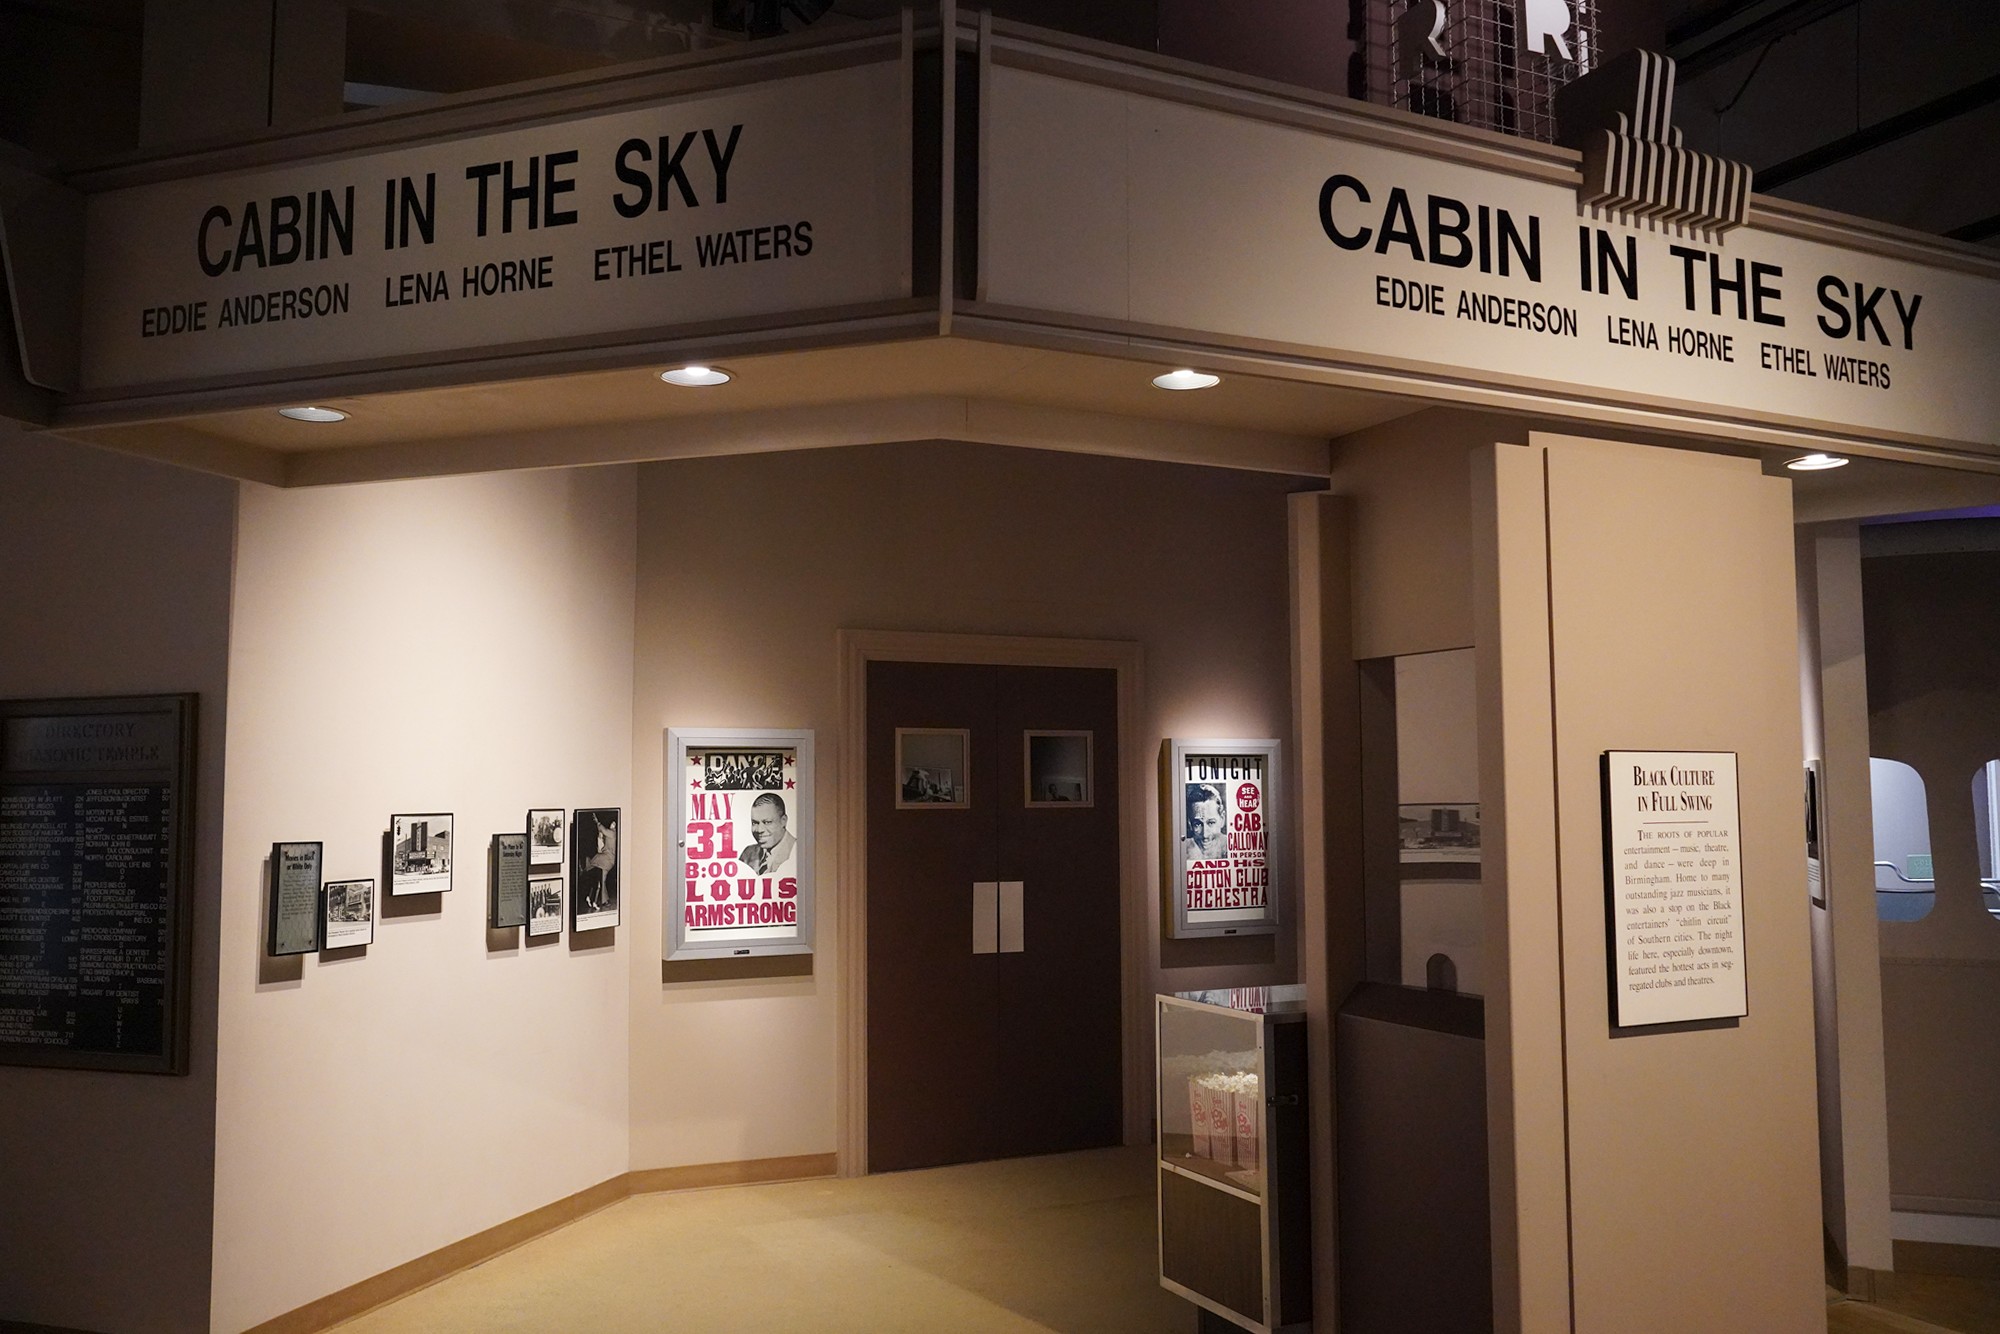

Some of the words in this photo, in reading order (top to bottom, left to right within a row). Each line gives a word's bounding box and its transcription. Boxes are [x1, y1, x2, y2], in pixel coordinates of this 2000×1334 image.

[198, 185, 354, 277] CABIN
[385, 173, 436, 250] IN
[466, 150, 578, 237] THE
[613, 124, 743, 218] SKY
[1319, 174, 1541, 282] CABIN
[1579, 225, 1638, 301] IN
[1670, 245, 1785, 327] THE
[1817, 275, 1923, 350] SKY
[142, 302, 207, 338] EDDIE
[218, 283, 349, 328] ANDERSON
[386, 270, 449, 307] LENA
[463, 256, 553, 298] HORNE
[594, 240, 682, 281] ETHEL
[696, 221, 813, 268] WATERS
[1376, 275, 1445, 316] EDDIE
[1457, 290, 1578, 337] ANDERSON
[1607, 315, 1659, 350] LENA
[1669, 326, 1734, 363] HORNE
[1761, 342, 1817, 377] ETHEL
[1824, 353, 1891, 389] WATERS
[46, 722, 137, 739] DIRECTORY
[1185, 758, 1262, 780] TONIGHT
[690, 793, 736, 821] MAY
[1240, 799, 1257, 807] HEAR
[1234, 813, 1261, 831] CAB
[687, 822, 738, 860] 31
[1228, 832, 1268, 851] CALLOWAY
[1624, 845, 1670, 855] entertainment
[685, 861, 738, 879] 8:00
[1192, 860, 1230, 869] AND
[1233, 859, 1265, 867] HIS
[1625, 861, 1637, 869] and
[1644, 860, 1665, 868] dance
[1700, 858, 1717, 868] deep
[1723, 857, 1729, 865] in
[1186, 869, 1231, 889] COTTON
[1236, 868, 1269, 887] CLUB
[1625, 876, 1672, 886] Birmingham.
[1676, 874, 1697, 882] Home
[1712, 874, 1730, 882] many
[686, 877, 797, 902] LOUIS
[1186, 887, 1268, 908] ORCHESTRA
[1626, 890, 1668, 900] outstanding
[1670, 890, 1683, 899] jazz
[1687, 888, 1722, 896] musicians,
[1726, 887, 1730, 895] it
[685, 901, 796, 927] ARMSTRONG
[1643, 905, 1656, 914] also
[1669, 904, 1682, 914] stop
[1699, 902, 1709, 910] the
[1713, 901, 1731, 910] Black
[1627, 936, 1634, 945] of
[1638, 935, 1671, 945] Southern
[1674, 933, 1694, 942] cities.
[1698, 931, 1711, 940] The
[1715, 930, 1732, 941] night
[1628, 951, 1639, 960] life
[1643, 950, 1659, 959] here,
[1663, 947, 1694, 960] especially
[1628, 965, 1656, 975] featured
[1659, 963, 1669, 972] the
[1672, 962, 1694, 972] hottest
[1697, 962, 1710, 970] acts
[1712, 960, 1718, 968] in
[1721, 961, 1734, 970] seg-
[1629, 982, 1654, 992] regated
[1655, 979, 1673, 988] clubs
[1674, 978, 1686, 986] and
[1687, 976, 1715, 986] theatres.
